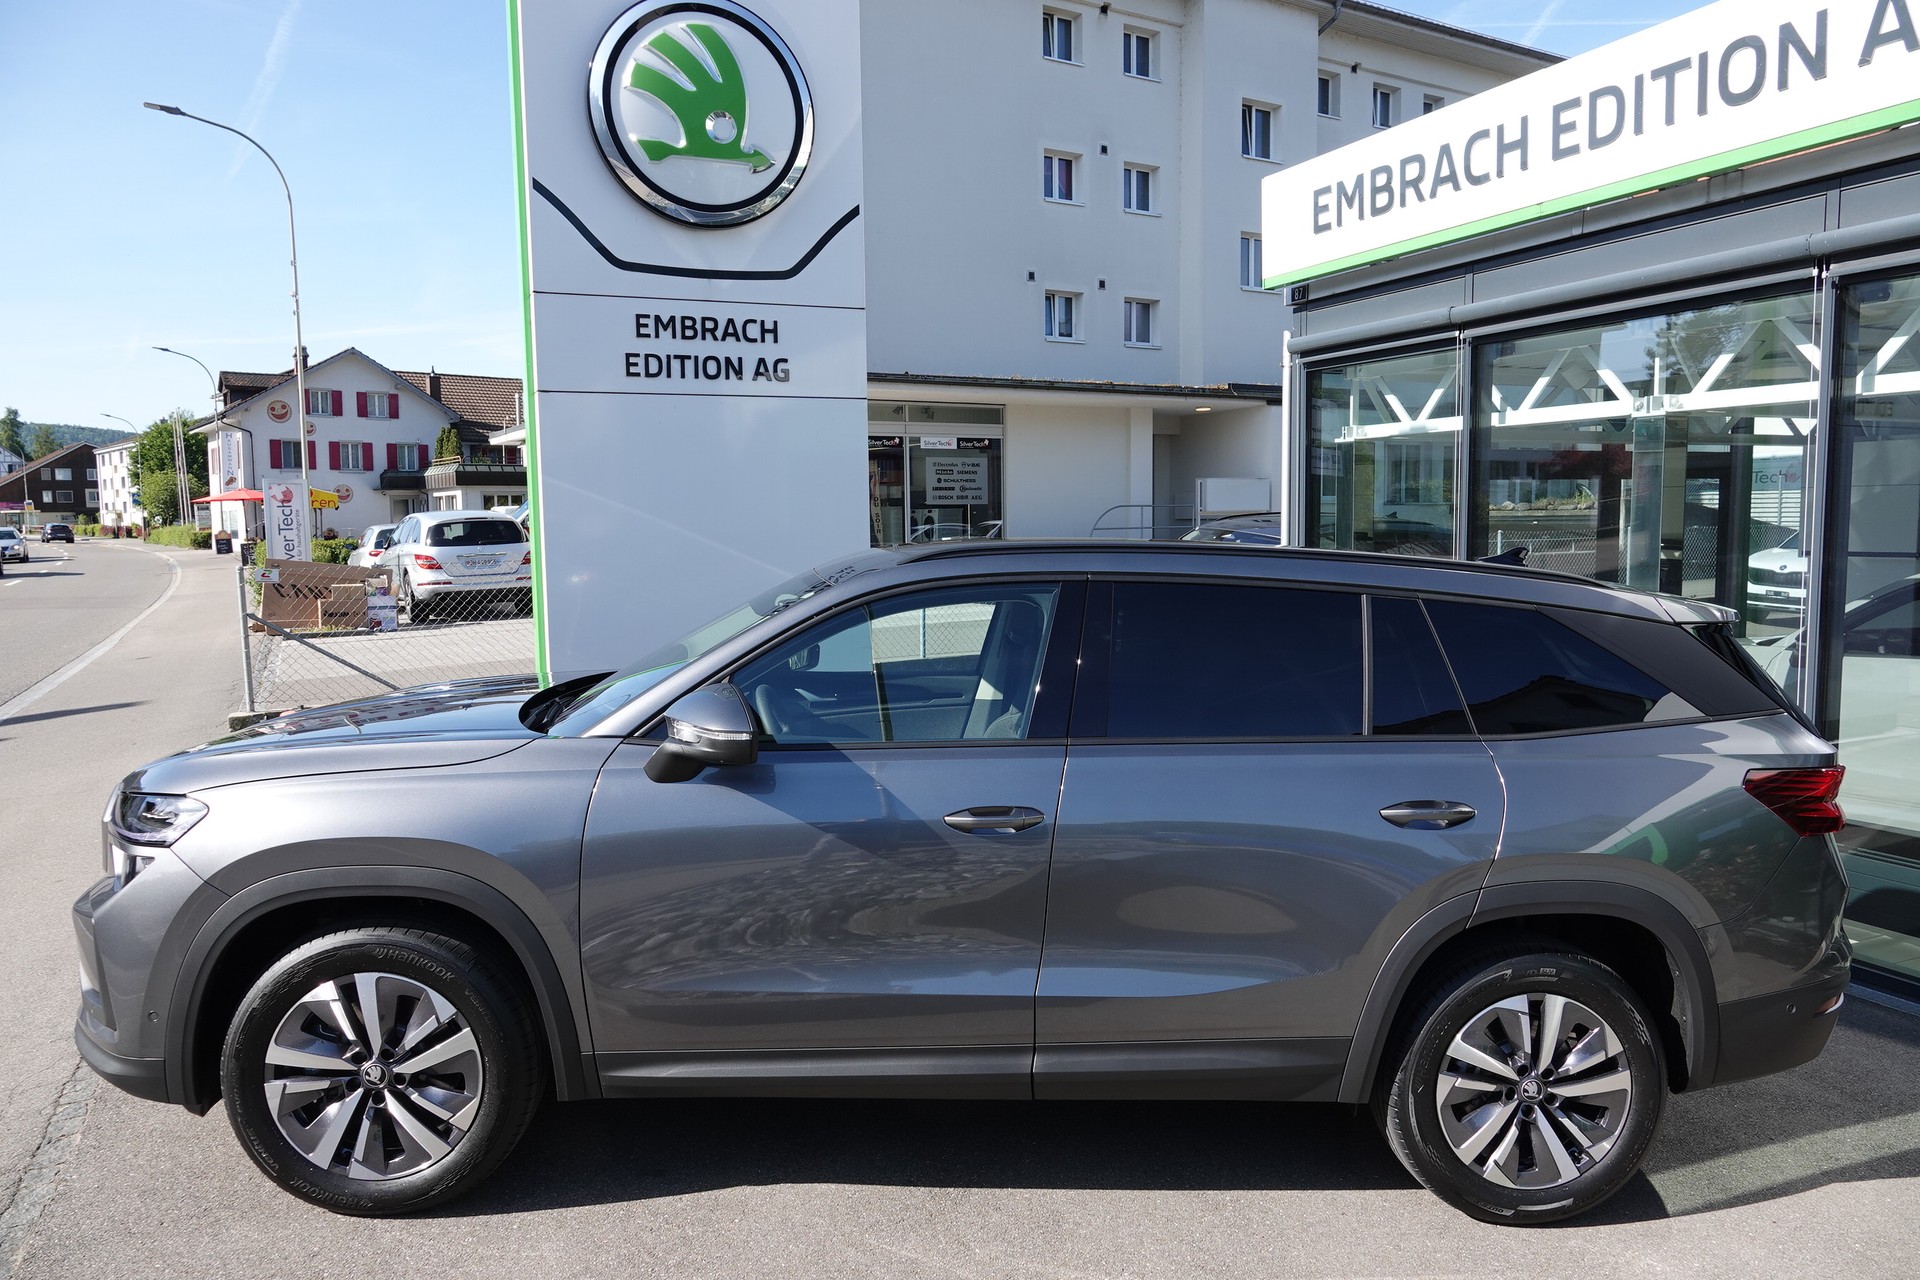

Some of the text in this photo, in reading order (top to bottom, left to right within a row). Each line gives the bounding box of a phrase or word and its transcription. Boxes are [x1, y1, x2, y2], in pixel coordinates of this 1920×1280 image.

[1313, 114, 1530, 235] EMBRACH
[1551, 7, 1828, 164] EDITION
[1294, 287, 1304, 300] 87
[635, 313, 779, 344] EMBRACH
[625, 352, 790, 382] EDITION AG
[311, 499, 337, 508] ren
[874, 512, 882, 535] SOIR
